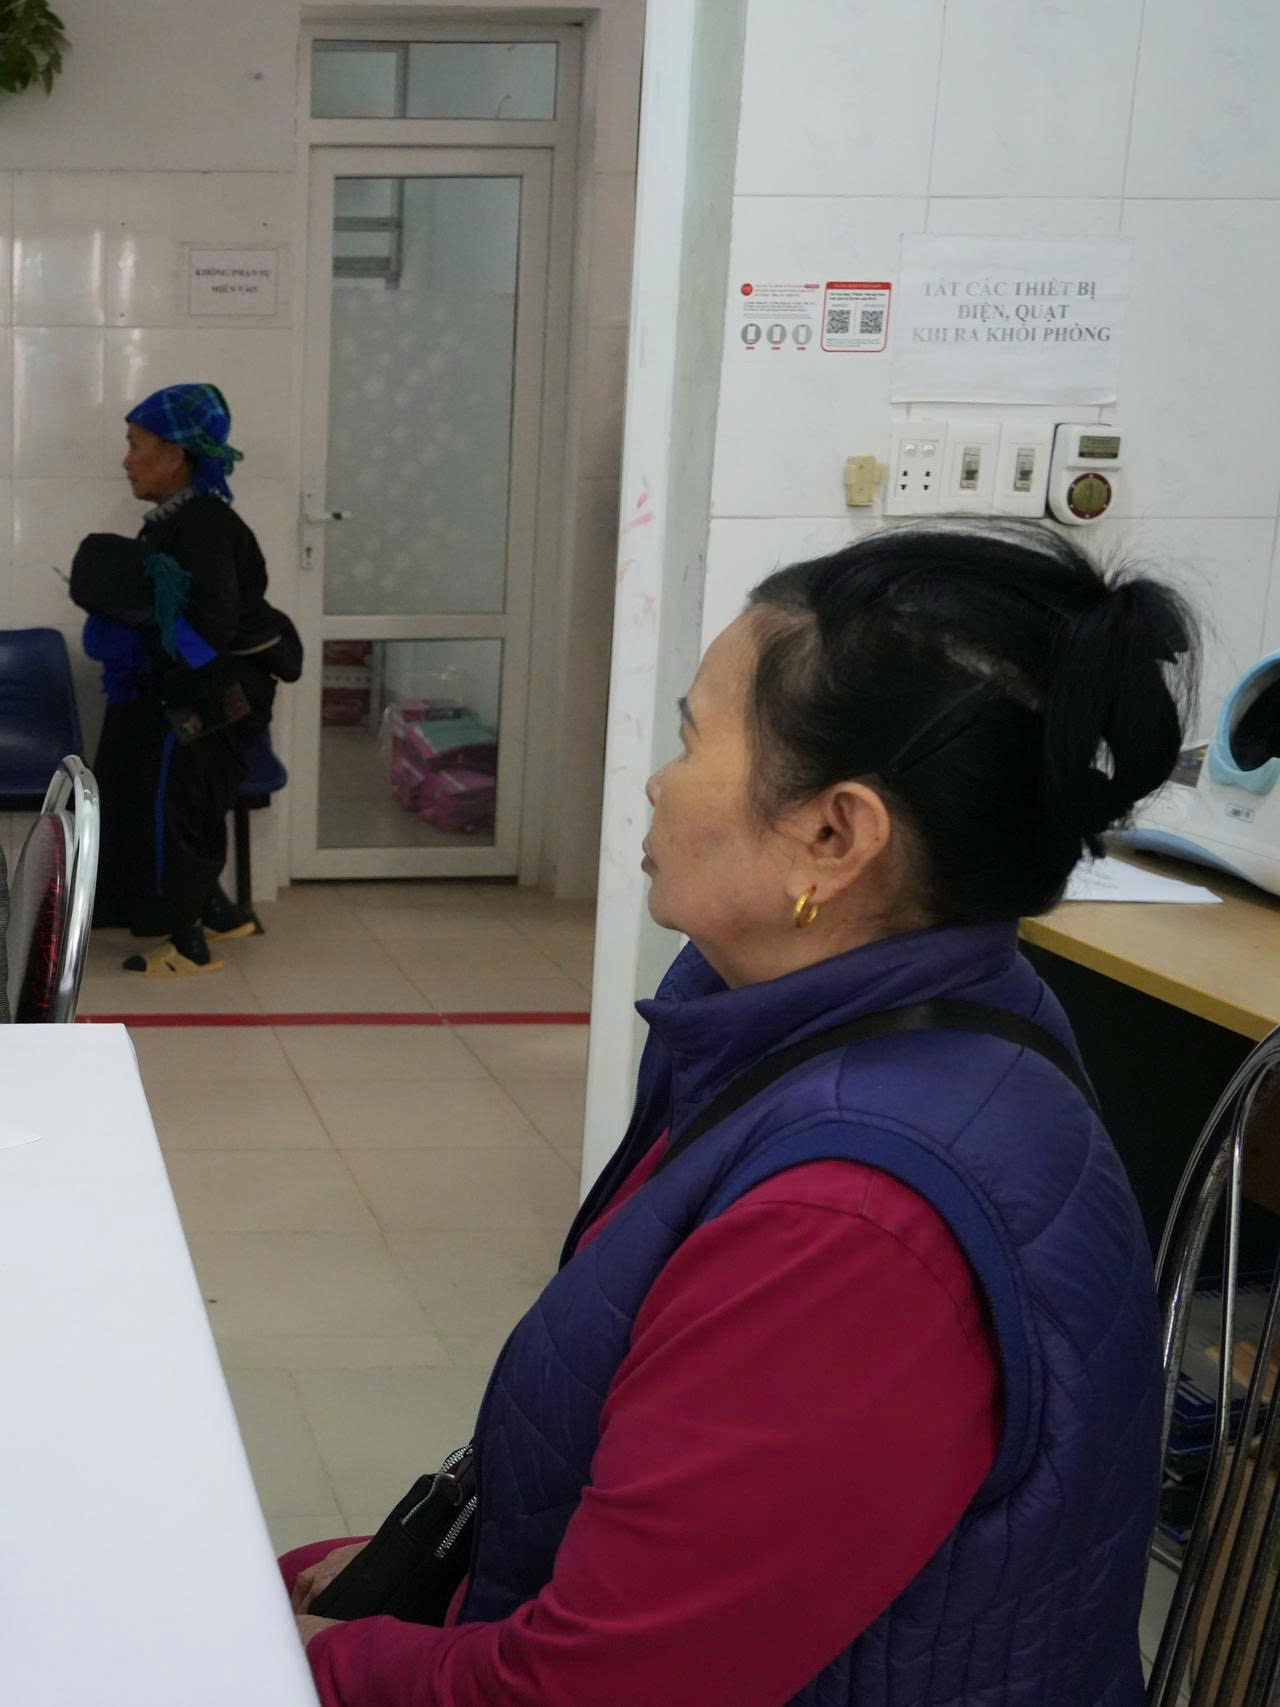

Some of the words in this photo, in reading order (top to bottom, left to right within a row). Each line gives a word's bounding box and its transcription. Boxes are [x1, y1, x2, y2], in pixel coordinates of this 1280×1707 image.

[965, 277, 1008, 297] CÁC
[1014, 276, 1073, 297] THIẾT
[1076, 281, 1096, 300] BỊ
[957, 302, 1010, 323] ĐIỆN,
[1015, 303, 1071, 323] QUẠT
[911, 326, 949, 342] KHI
[954, 326, 980, 342] RA
[986, 323, 1037, 342] KHỎI
[1043, 322, 1112, 342] PHÒNG
